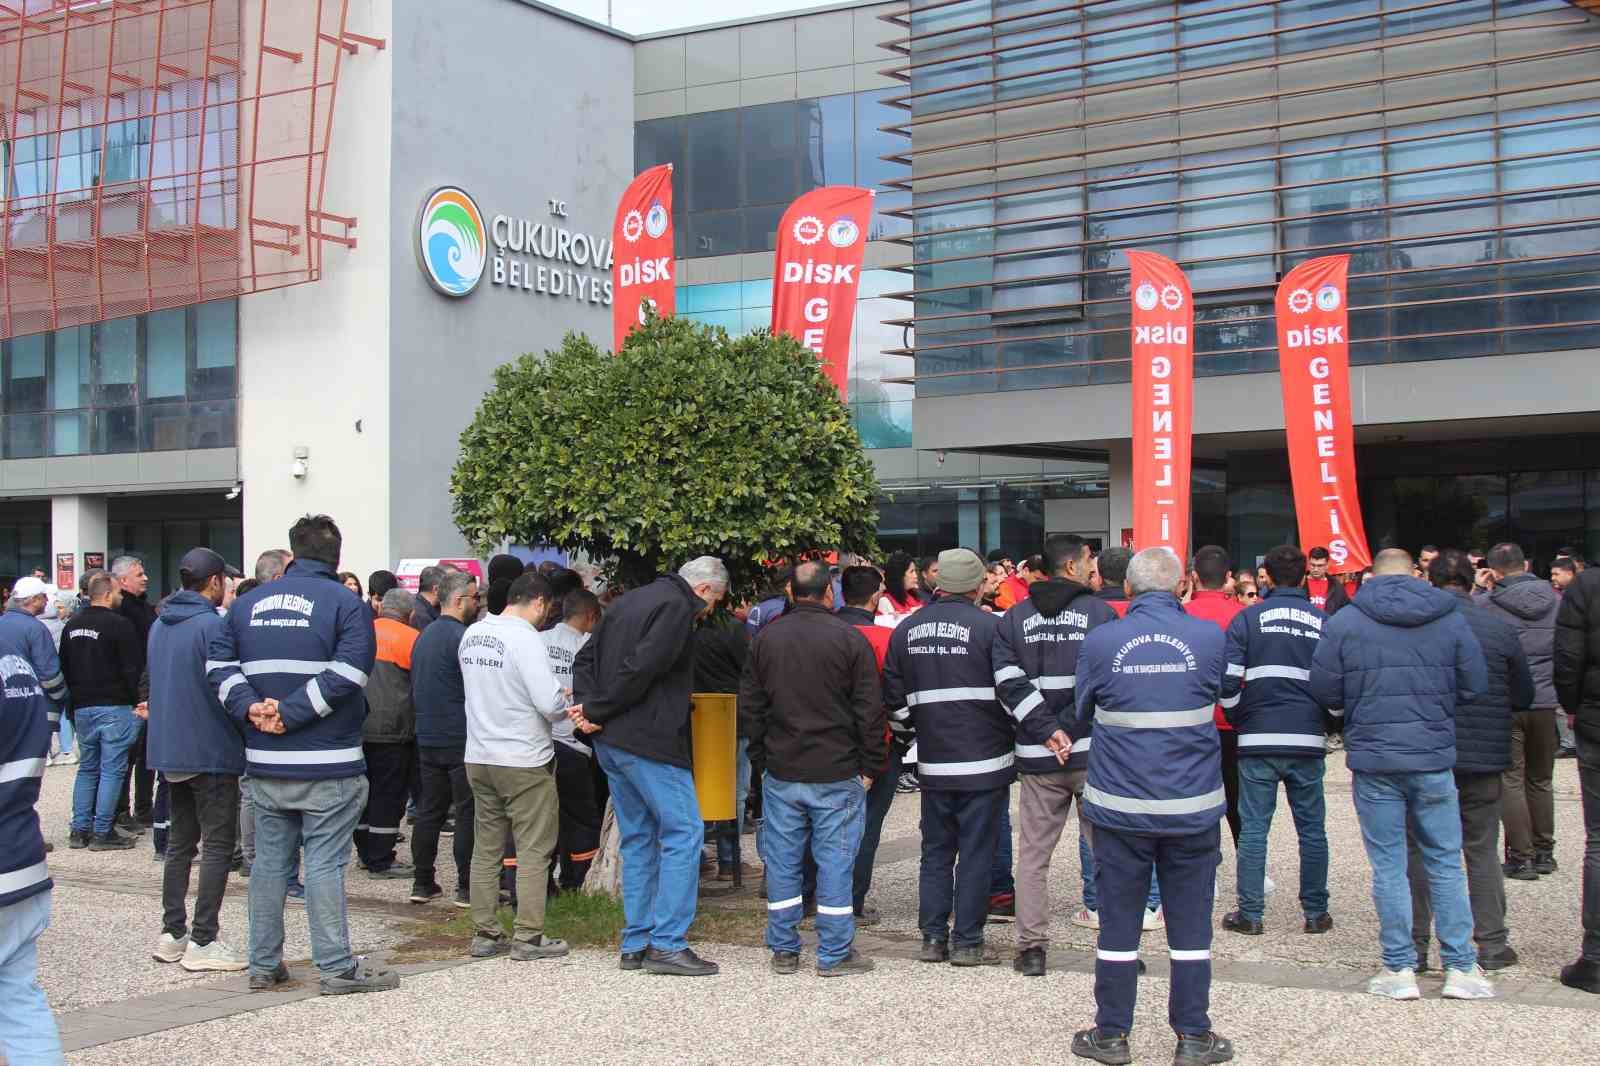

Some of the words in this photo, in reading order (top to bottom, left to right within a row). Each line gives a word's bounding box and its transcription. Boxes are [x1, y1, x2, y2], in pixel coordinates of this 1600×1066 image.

[620, 257, 671, 288] DİSK
[783, 258, 855, 285] DİSK
[1287, 324, 1344, 348] DİSK
